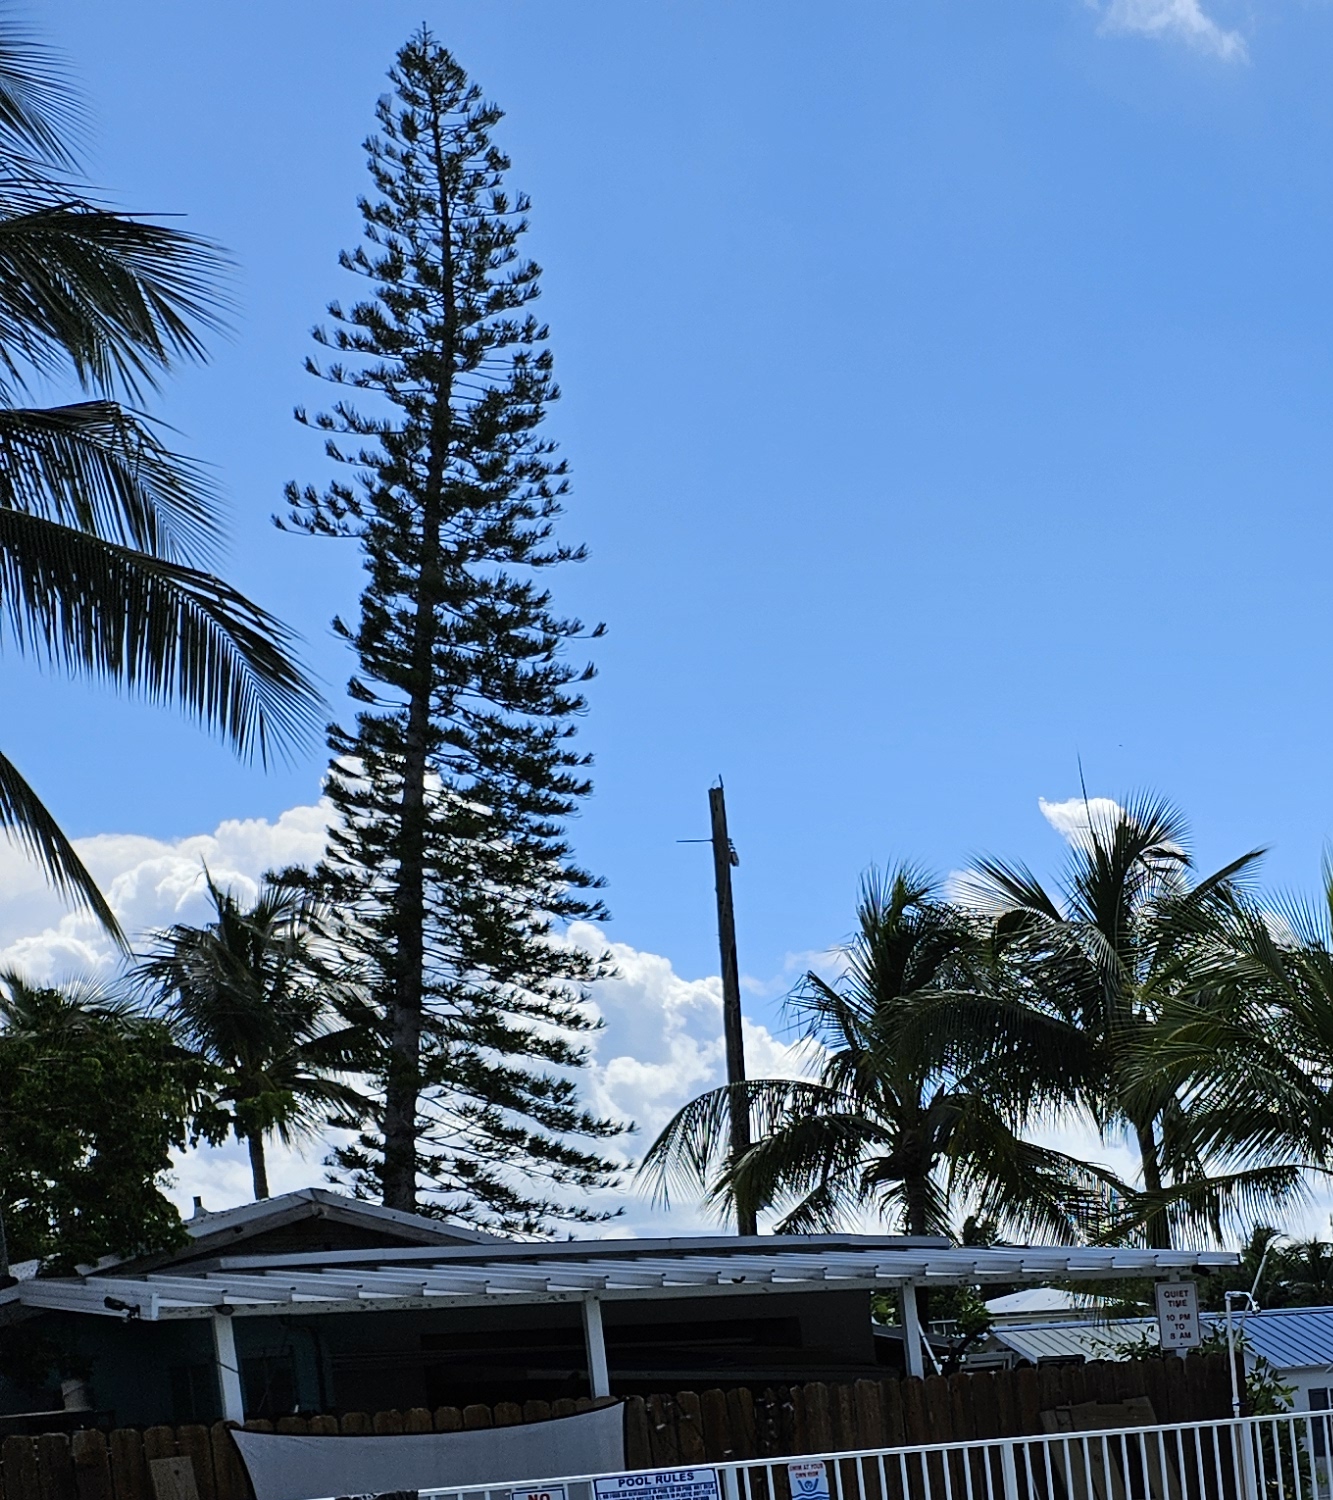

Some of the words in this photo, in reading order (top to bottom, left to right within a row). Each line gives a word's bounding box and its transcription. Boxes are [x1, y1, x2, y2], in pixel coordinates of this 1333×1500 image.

[1164, 1290, 1188, 1298] QUIET
[618, 1477, 651, 1487] POOL
[656, 1472, 694, 1483] RULES
